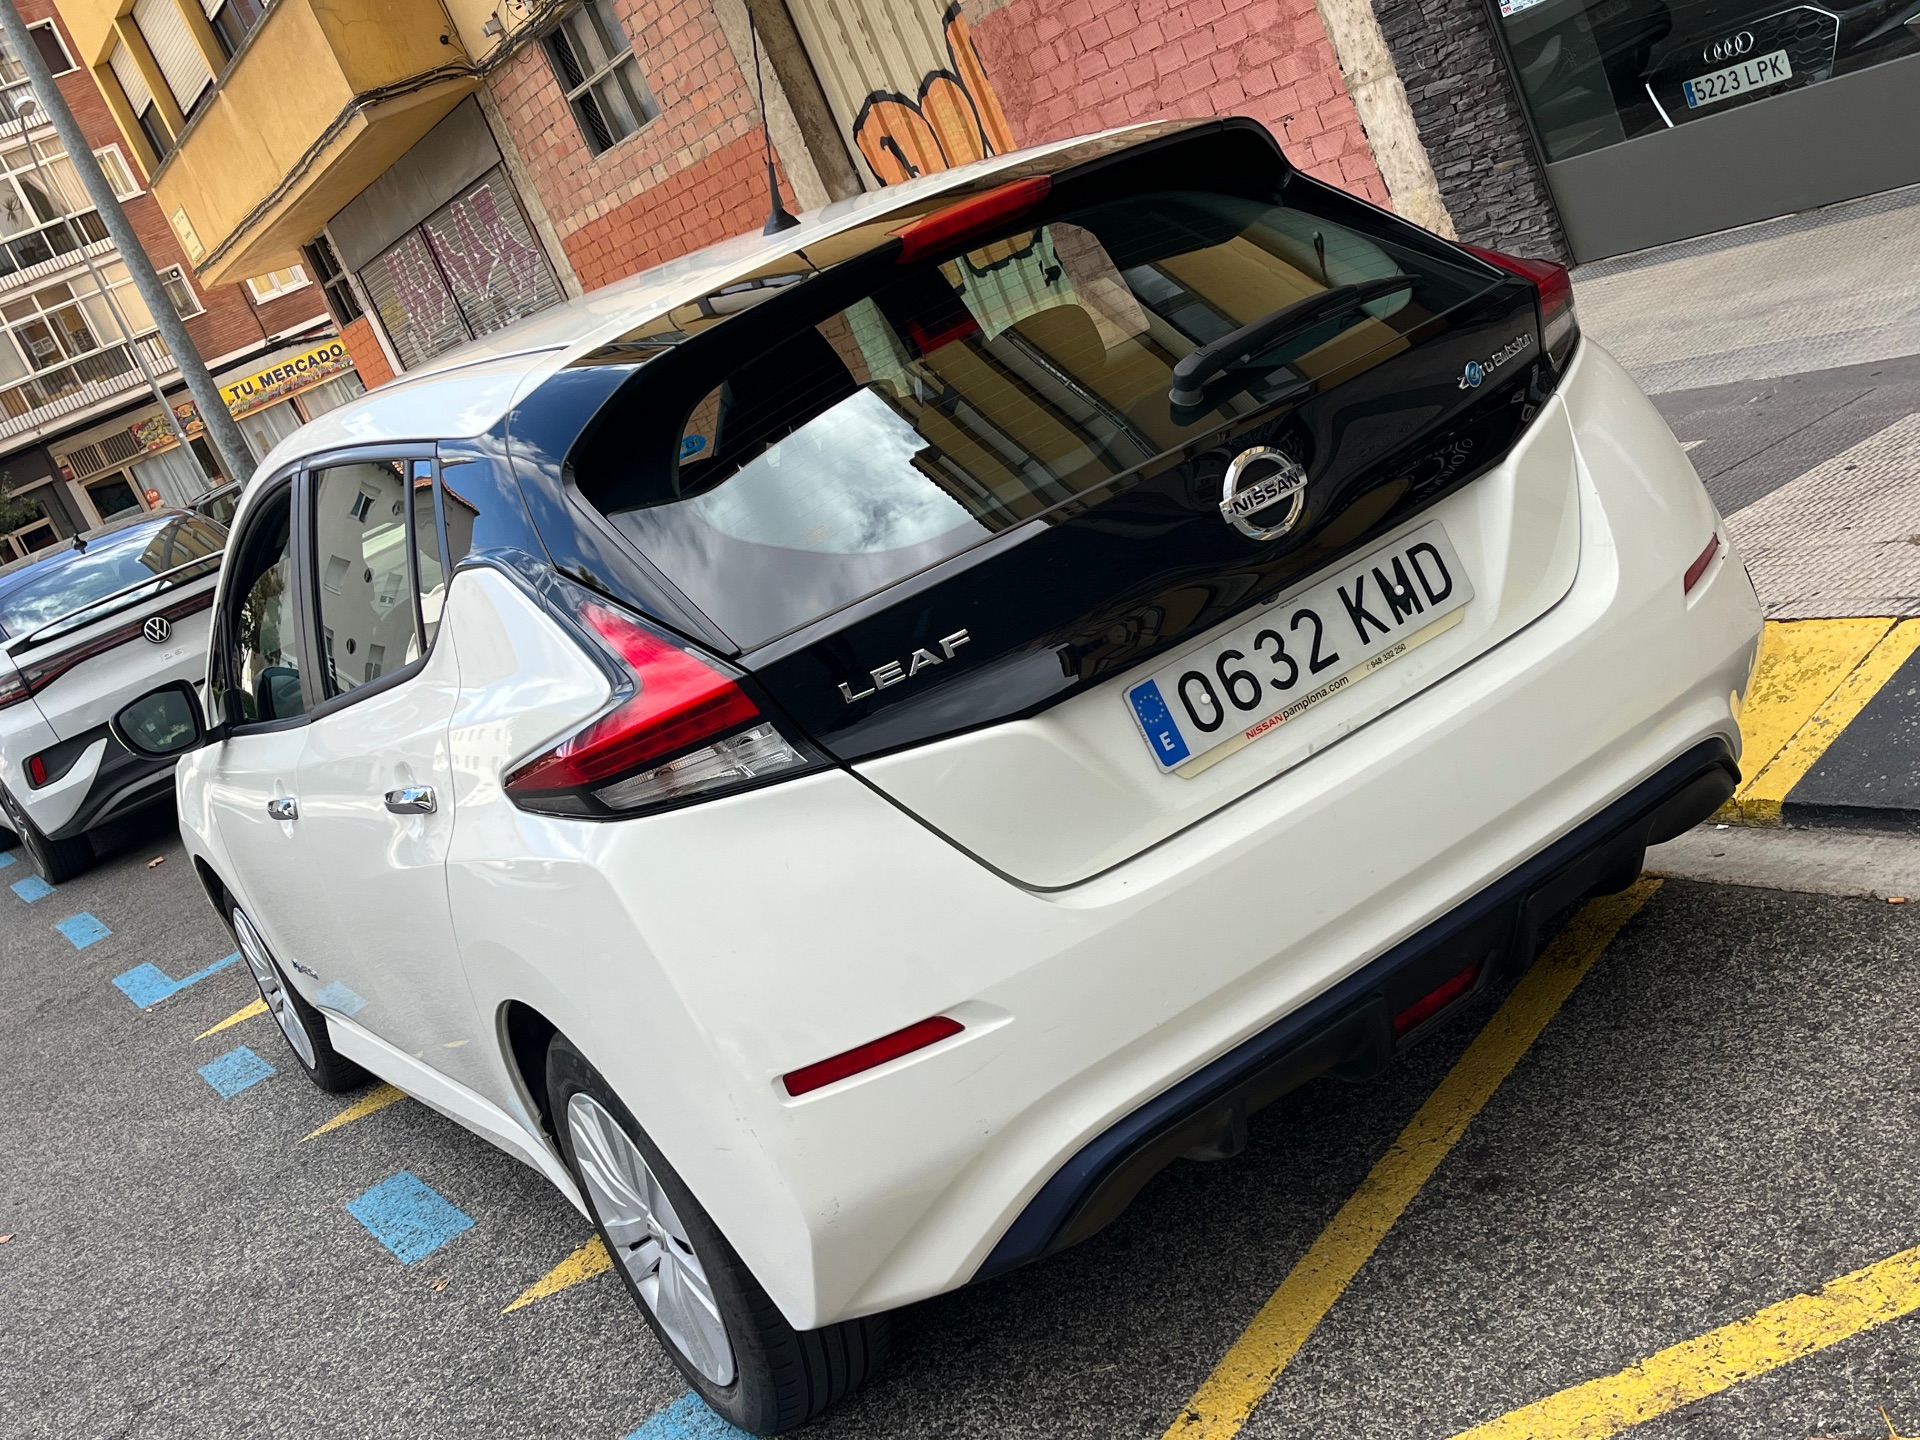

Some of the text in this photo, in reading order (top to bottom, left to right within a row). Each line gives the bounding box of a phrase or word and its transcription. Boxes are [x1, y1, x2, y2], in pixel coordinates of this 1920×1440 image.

[1694, 55, 1784, 101] 5223 LPK
[229, 344, 343, 400] TU MERCADO
[1232, 471, 1301, 515] NISSAN
[1177, 542, 1454, 733] 0632 KMD
[1382, 649, 1395, 662] 332
[1393, 643, 1407, 655] 250
[838, 628, 971, 704] LEAF
[1159, 730, 1176, 752] E
